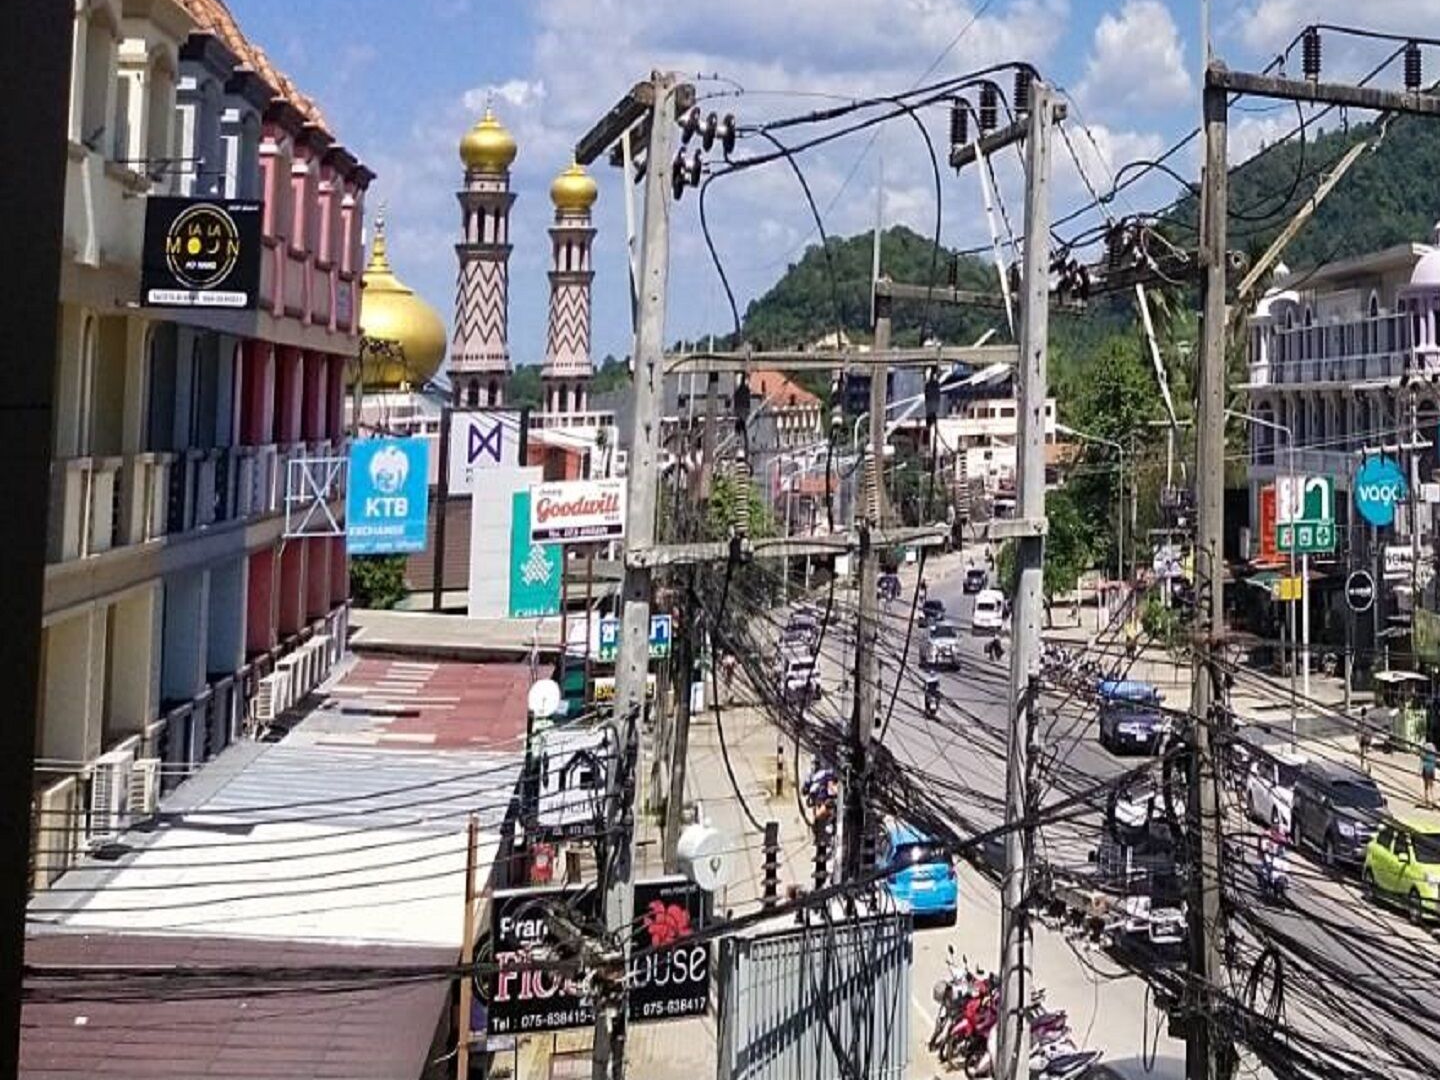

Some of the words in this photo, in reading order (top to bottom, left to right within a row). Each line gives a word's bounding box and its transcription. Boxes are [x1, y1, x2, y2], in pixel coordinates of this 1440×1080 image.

[366, 497, 408, 517] KTB
[537, 491, 620, 524] Goodwill
[632, 946, 707, 989] ouse
[493, 1016, 510, 1033] Tel
